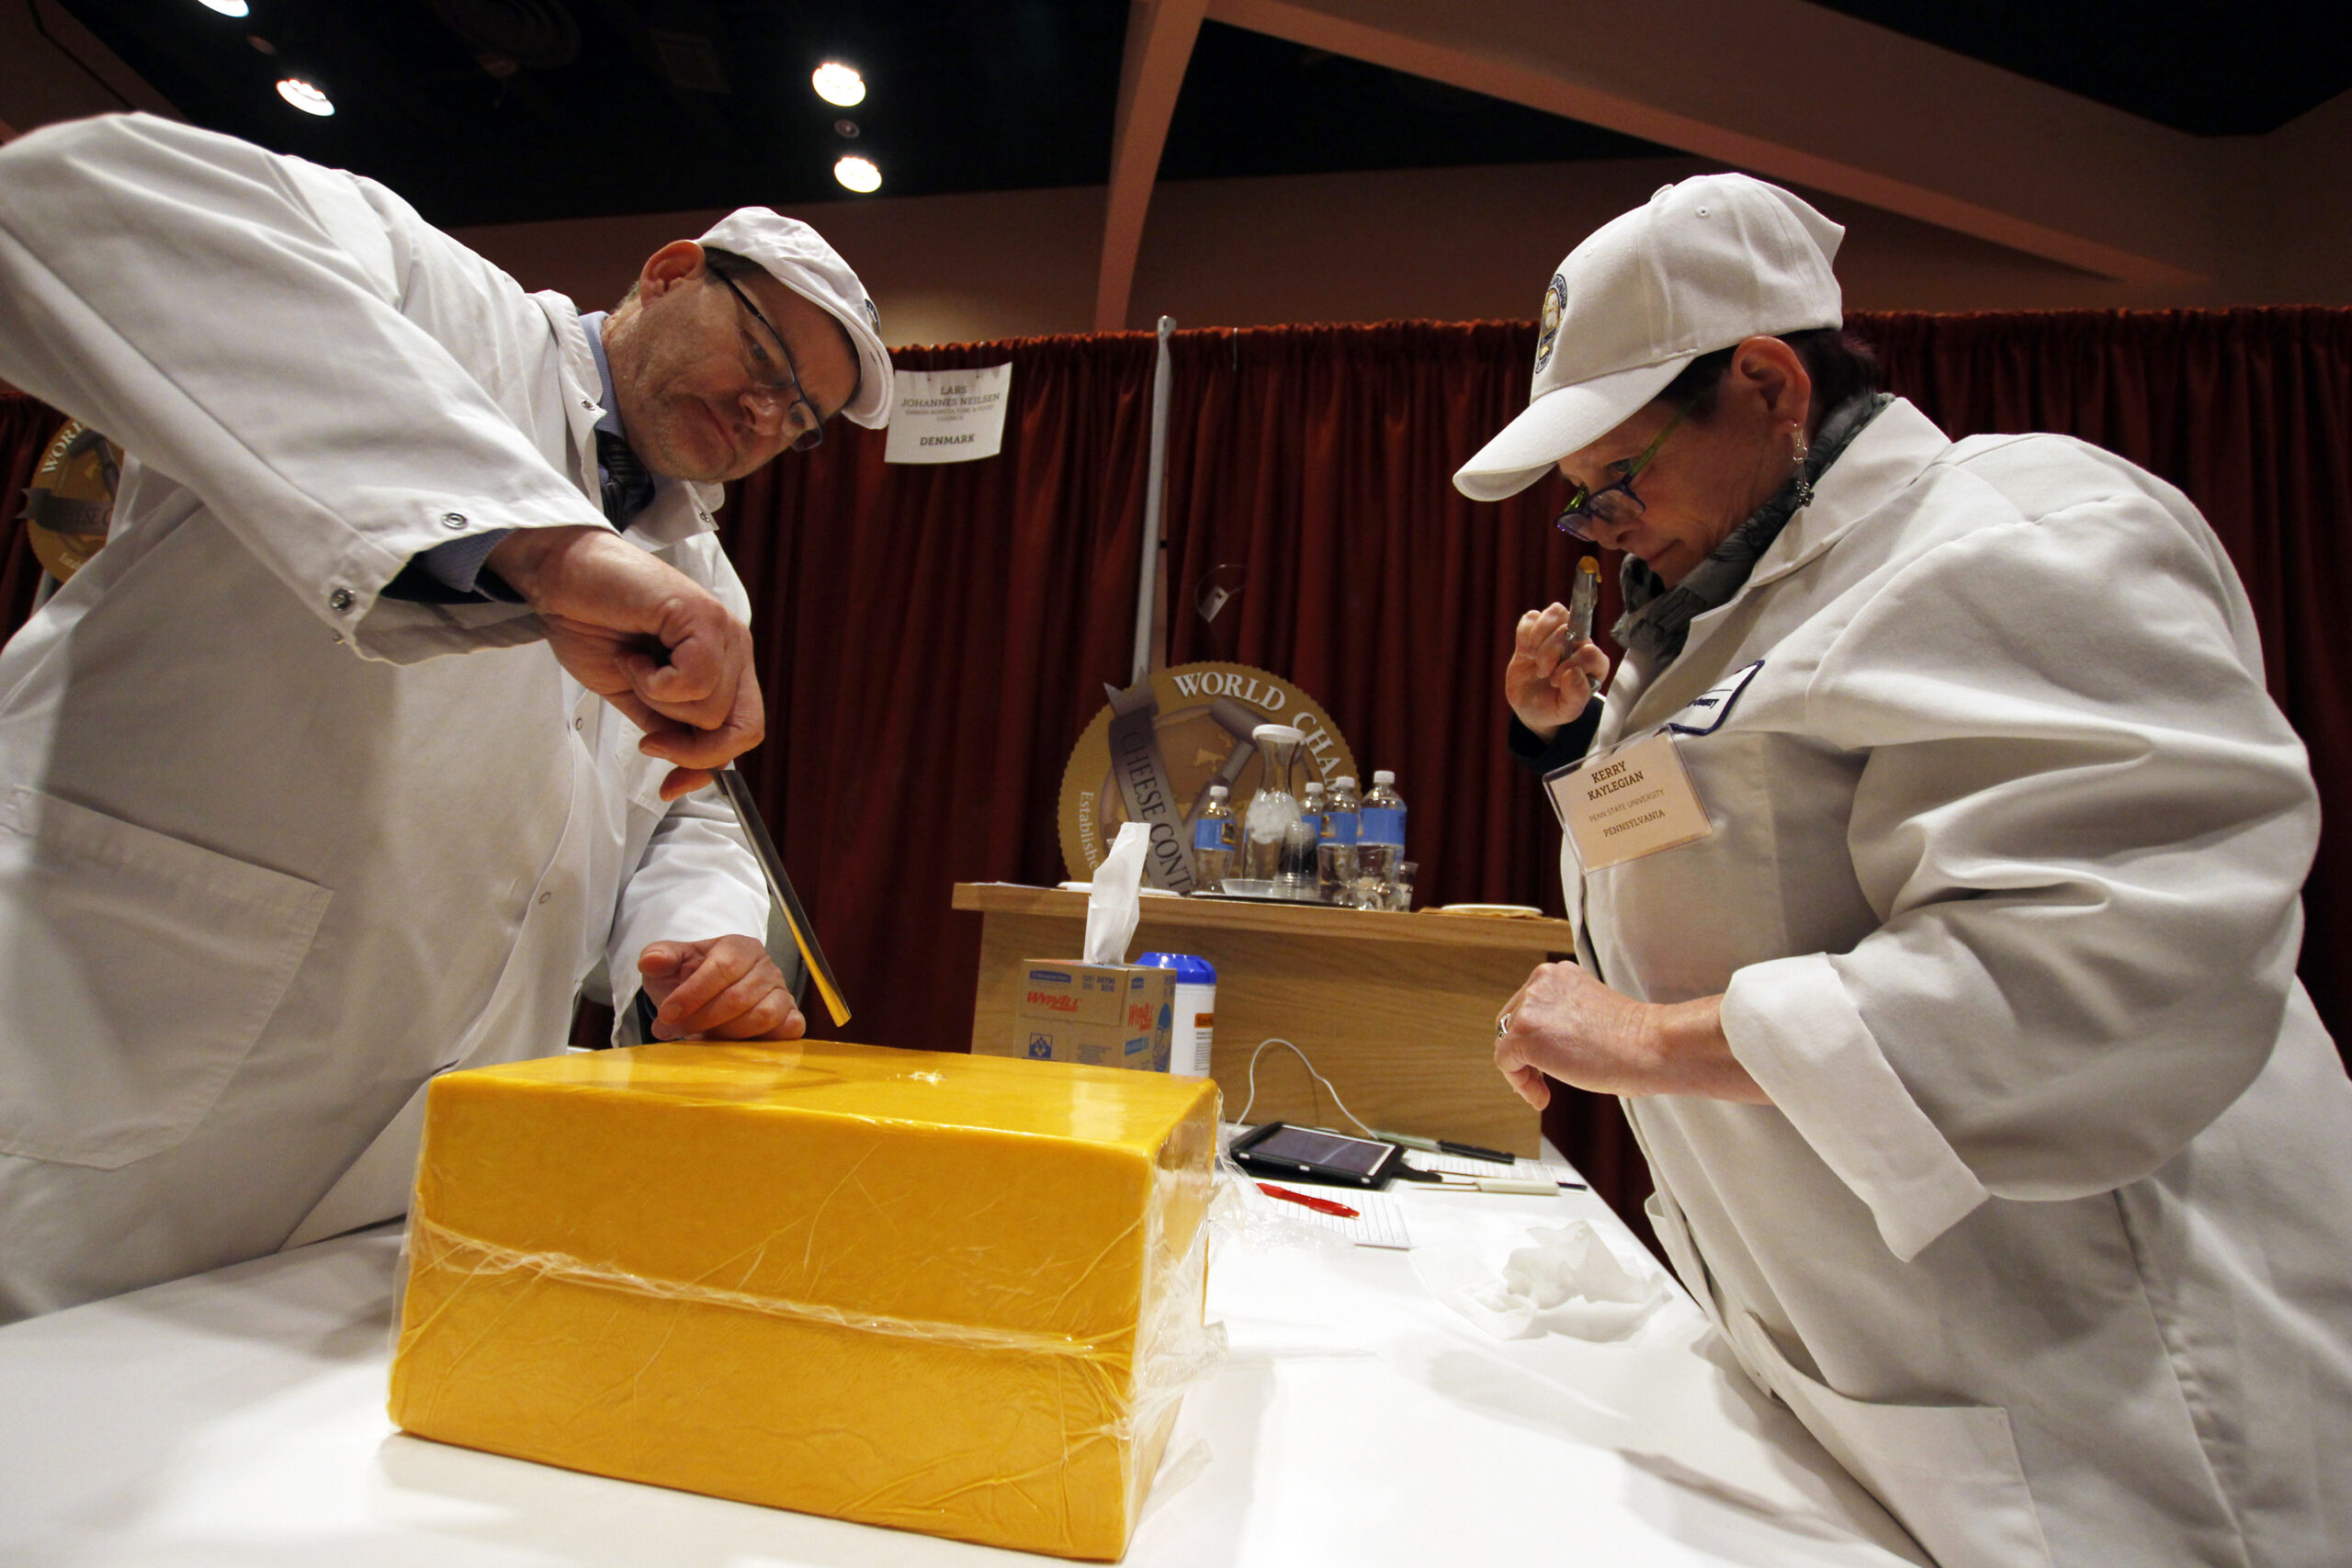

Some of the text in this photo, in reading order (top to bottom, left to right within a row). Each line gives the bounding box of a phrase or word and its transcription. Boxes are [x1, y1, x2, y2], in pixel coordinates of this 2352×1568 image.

[901, 398, 957, 407] JOHANNES
[940, 385, 967, 395] LARS
[920, 434, 976, 446] DENMARK
[1173, 671, 1285, 711] WORLD
[1588, 771, 1644, 800] KAYLEGIAN
[1591, 761, 1626, 784] KERRY
[1122, 732, 1193, 897] CHEESE CONT
[1589, 787, 1665, 821] PENN STATE UNIVERSITY
[1603, 809, 1666, 837] PENNSYLVANIA
